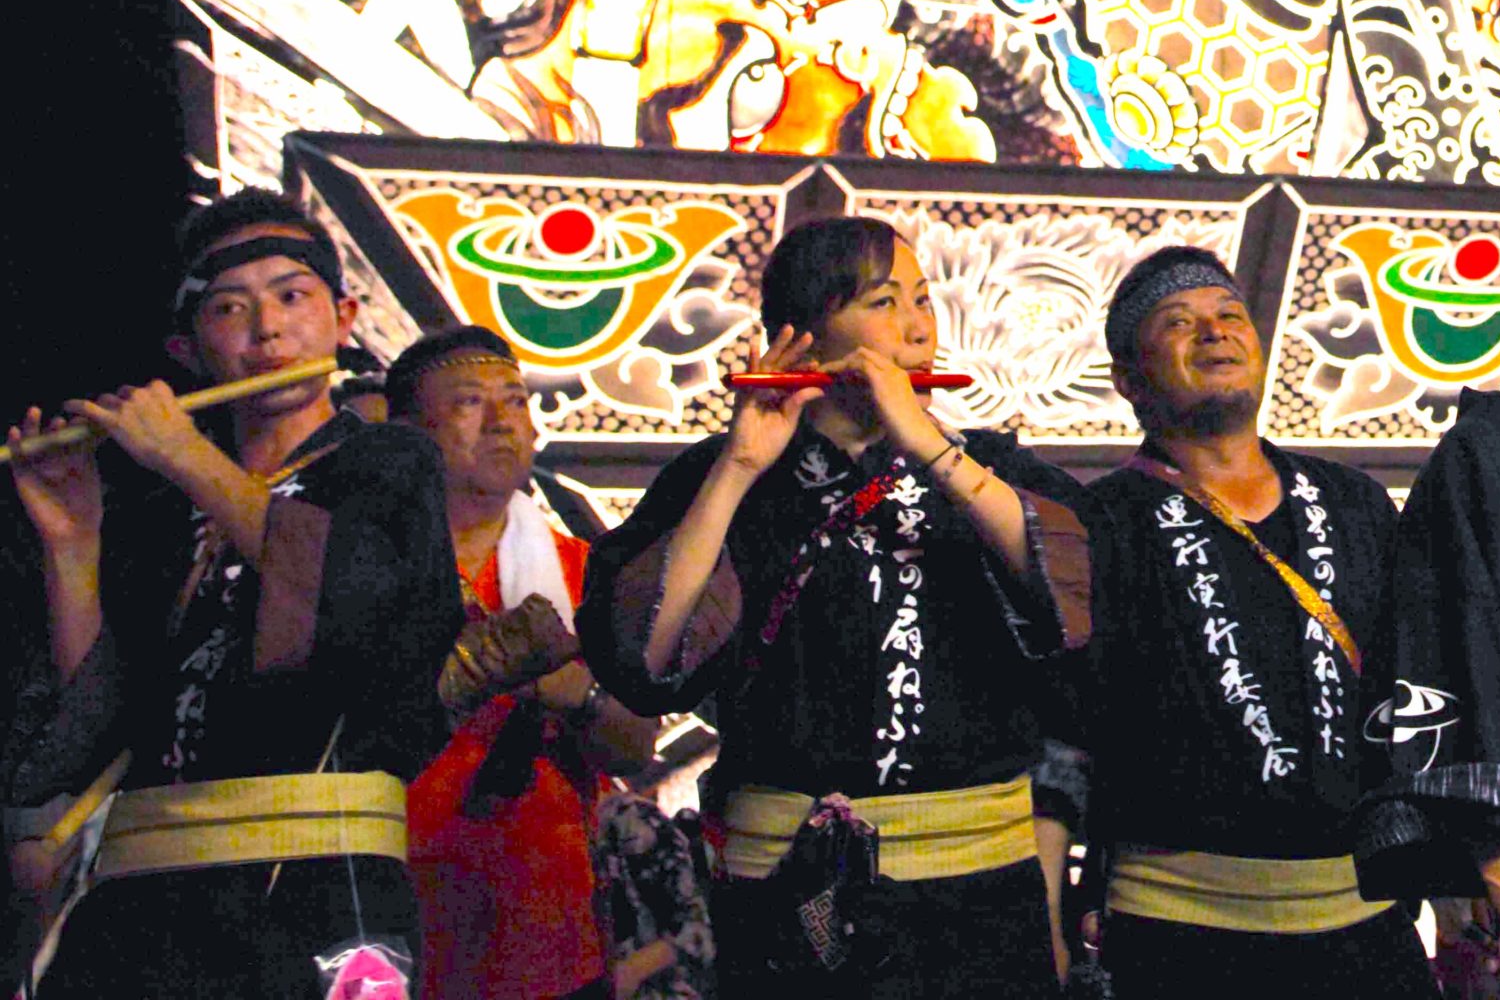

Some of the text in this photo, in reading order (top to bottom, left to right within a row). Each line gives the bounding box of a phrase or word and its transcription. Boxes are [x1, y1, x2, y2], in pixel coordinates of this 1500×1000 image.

[876, 473, 932, 786] 世界一の扇ねぷた
[1155, 495, 1298, 781] 運行実行委員会
